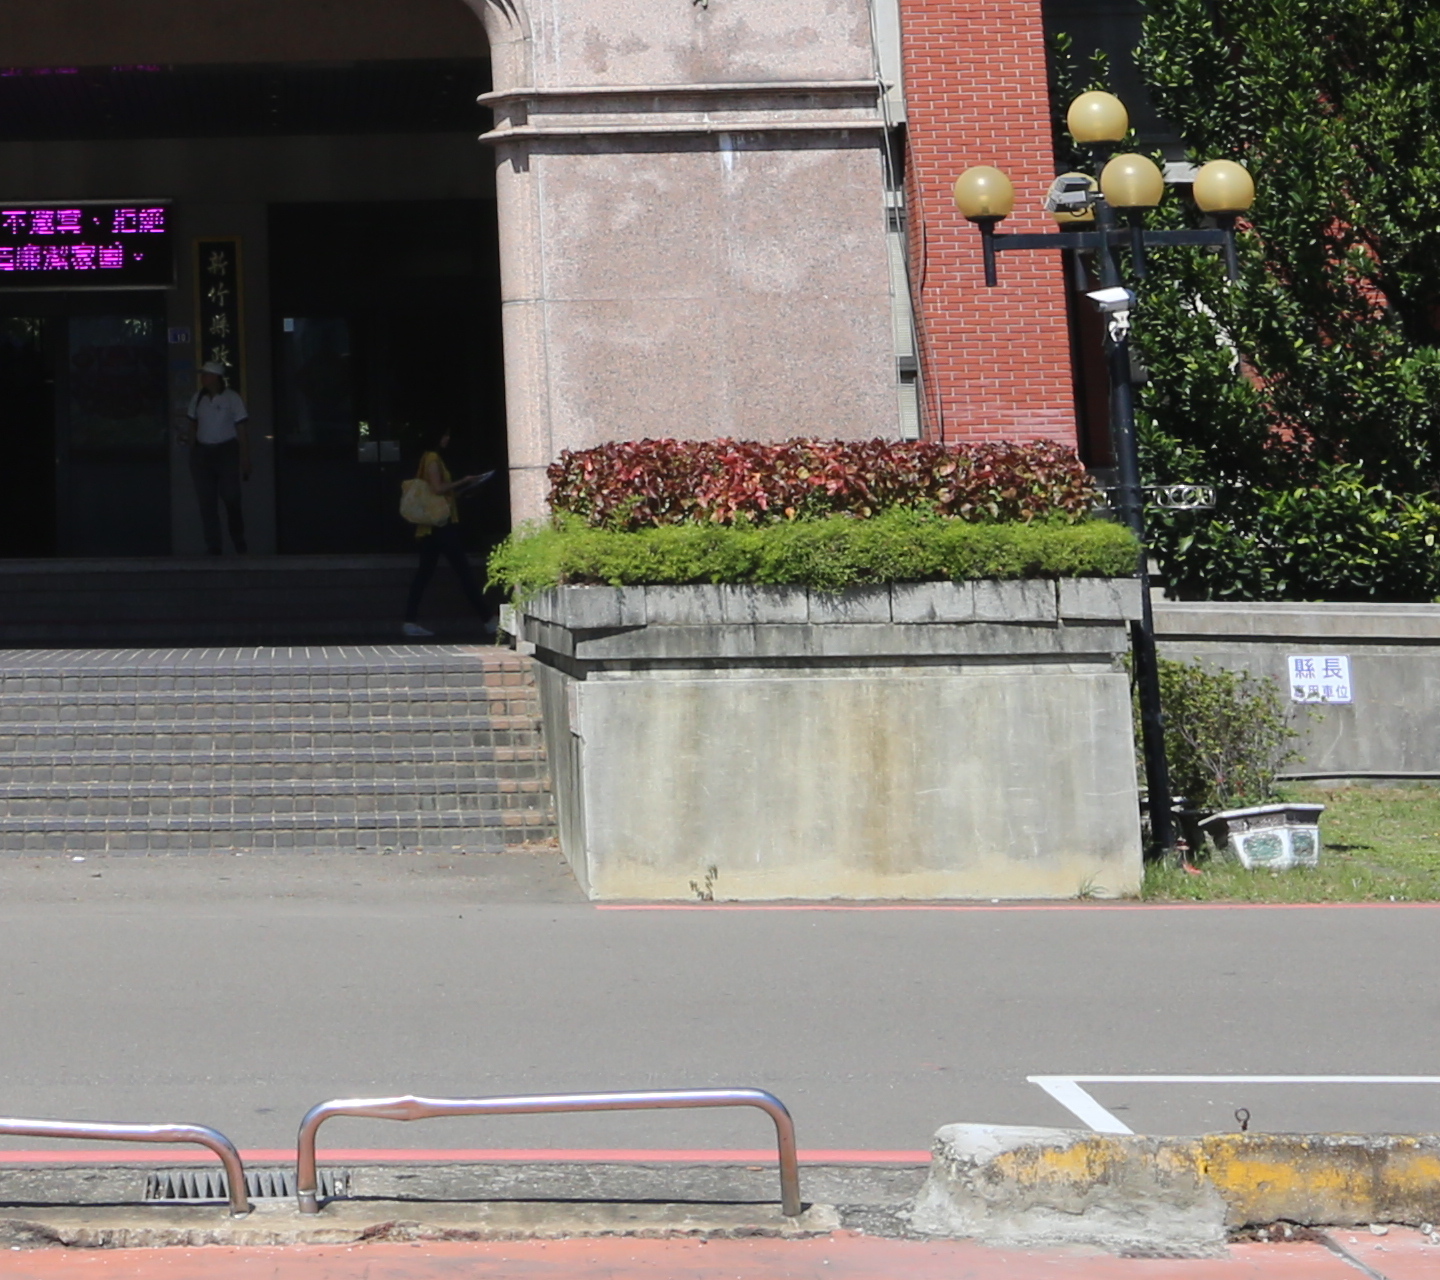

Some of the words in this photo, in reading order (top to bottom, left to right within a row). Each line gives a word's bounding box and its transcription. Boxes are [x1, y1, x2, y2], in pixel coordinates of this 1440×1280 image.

[207, 251, 233, 387] 新竹縣政
[1294, 658, 1343, 679] 縣長
